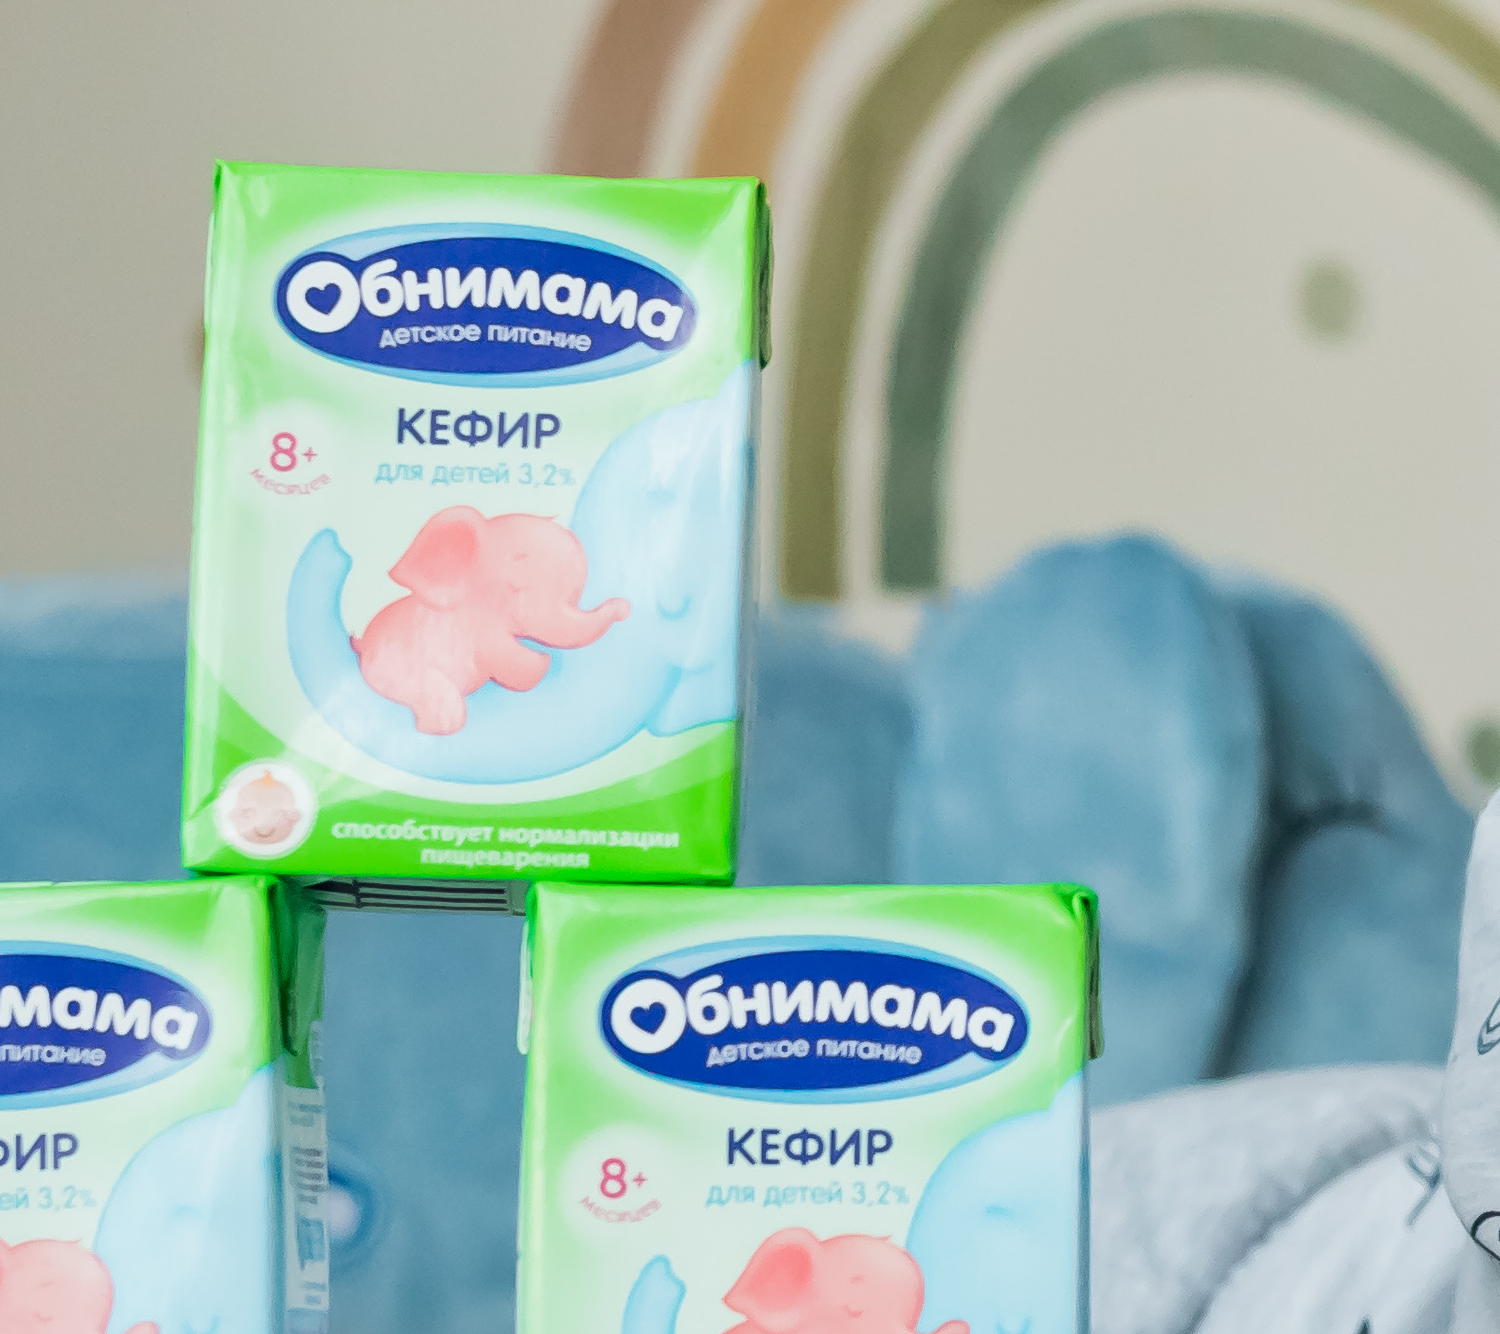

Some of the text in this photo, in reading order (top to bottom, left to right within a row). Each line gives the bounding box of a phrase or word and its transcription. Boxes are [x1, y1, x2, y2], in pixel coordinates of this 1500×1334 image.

[286, 259, 683, 342] Обнимама
[380, 322, 592, 352] детское питание
[397, 408, 561, 449] КЕФИР
[270, 433, 318, 472] 8+
[375, 464, 424, 486] для
[432, 463, 509, 486] детей
[332, 820, 493, 847] способствует
[611, 975, 1014, 1054] Обнимама
[0, 1042, 106, 1067] питание
[706, 1038, 922, 1068] детское питание
[726, 1128, 893, 1166] КЕФИР
[600, 1158, 647, 1199] 8+
[706, 1184, 756, 1207] для
[764, 1180, 842, 1207] детей
